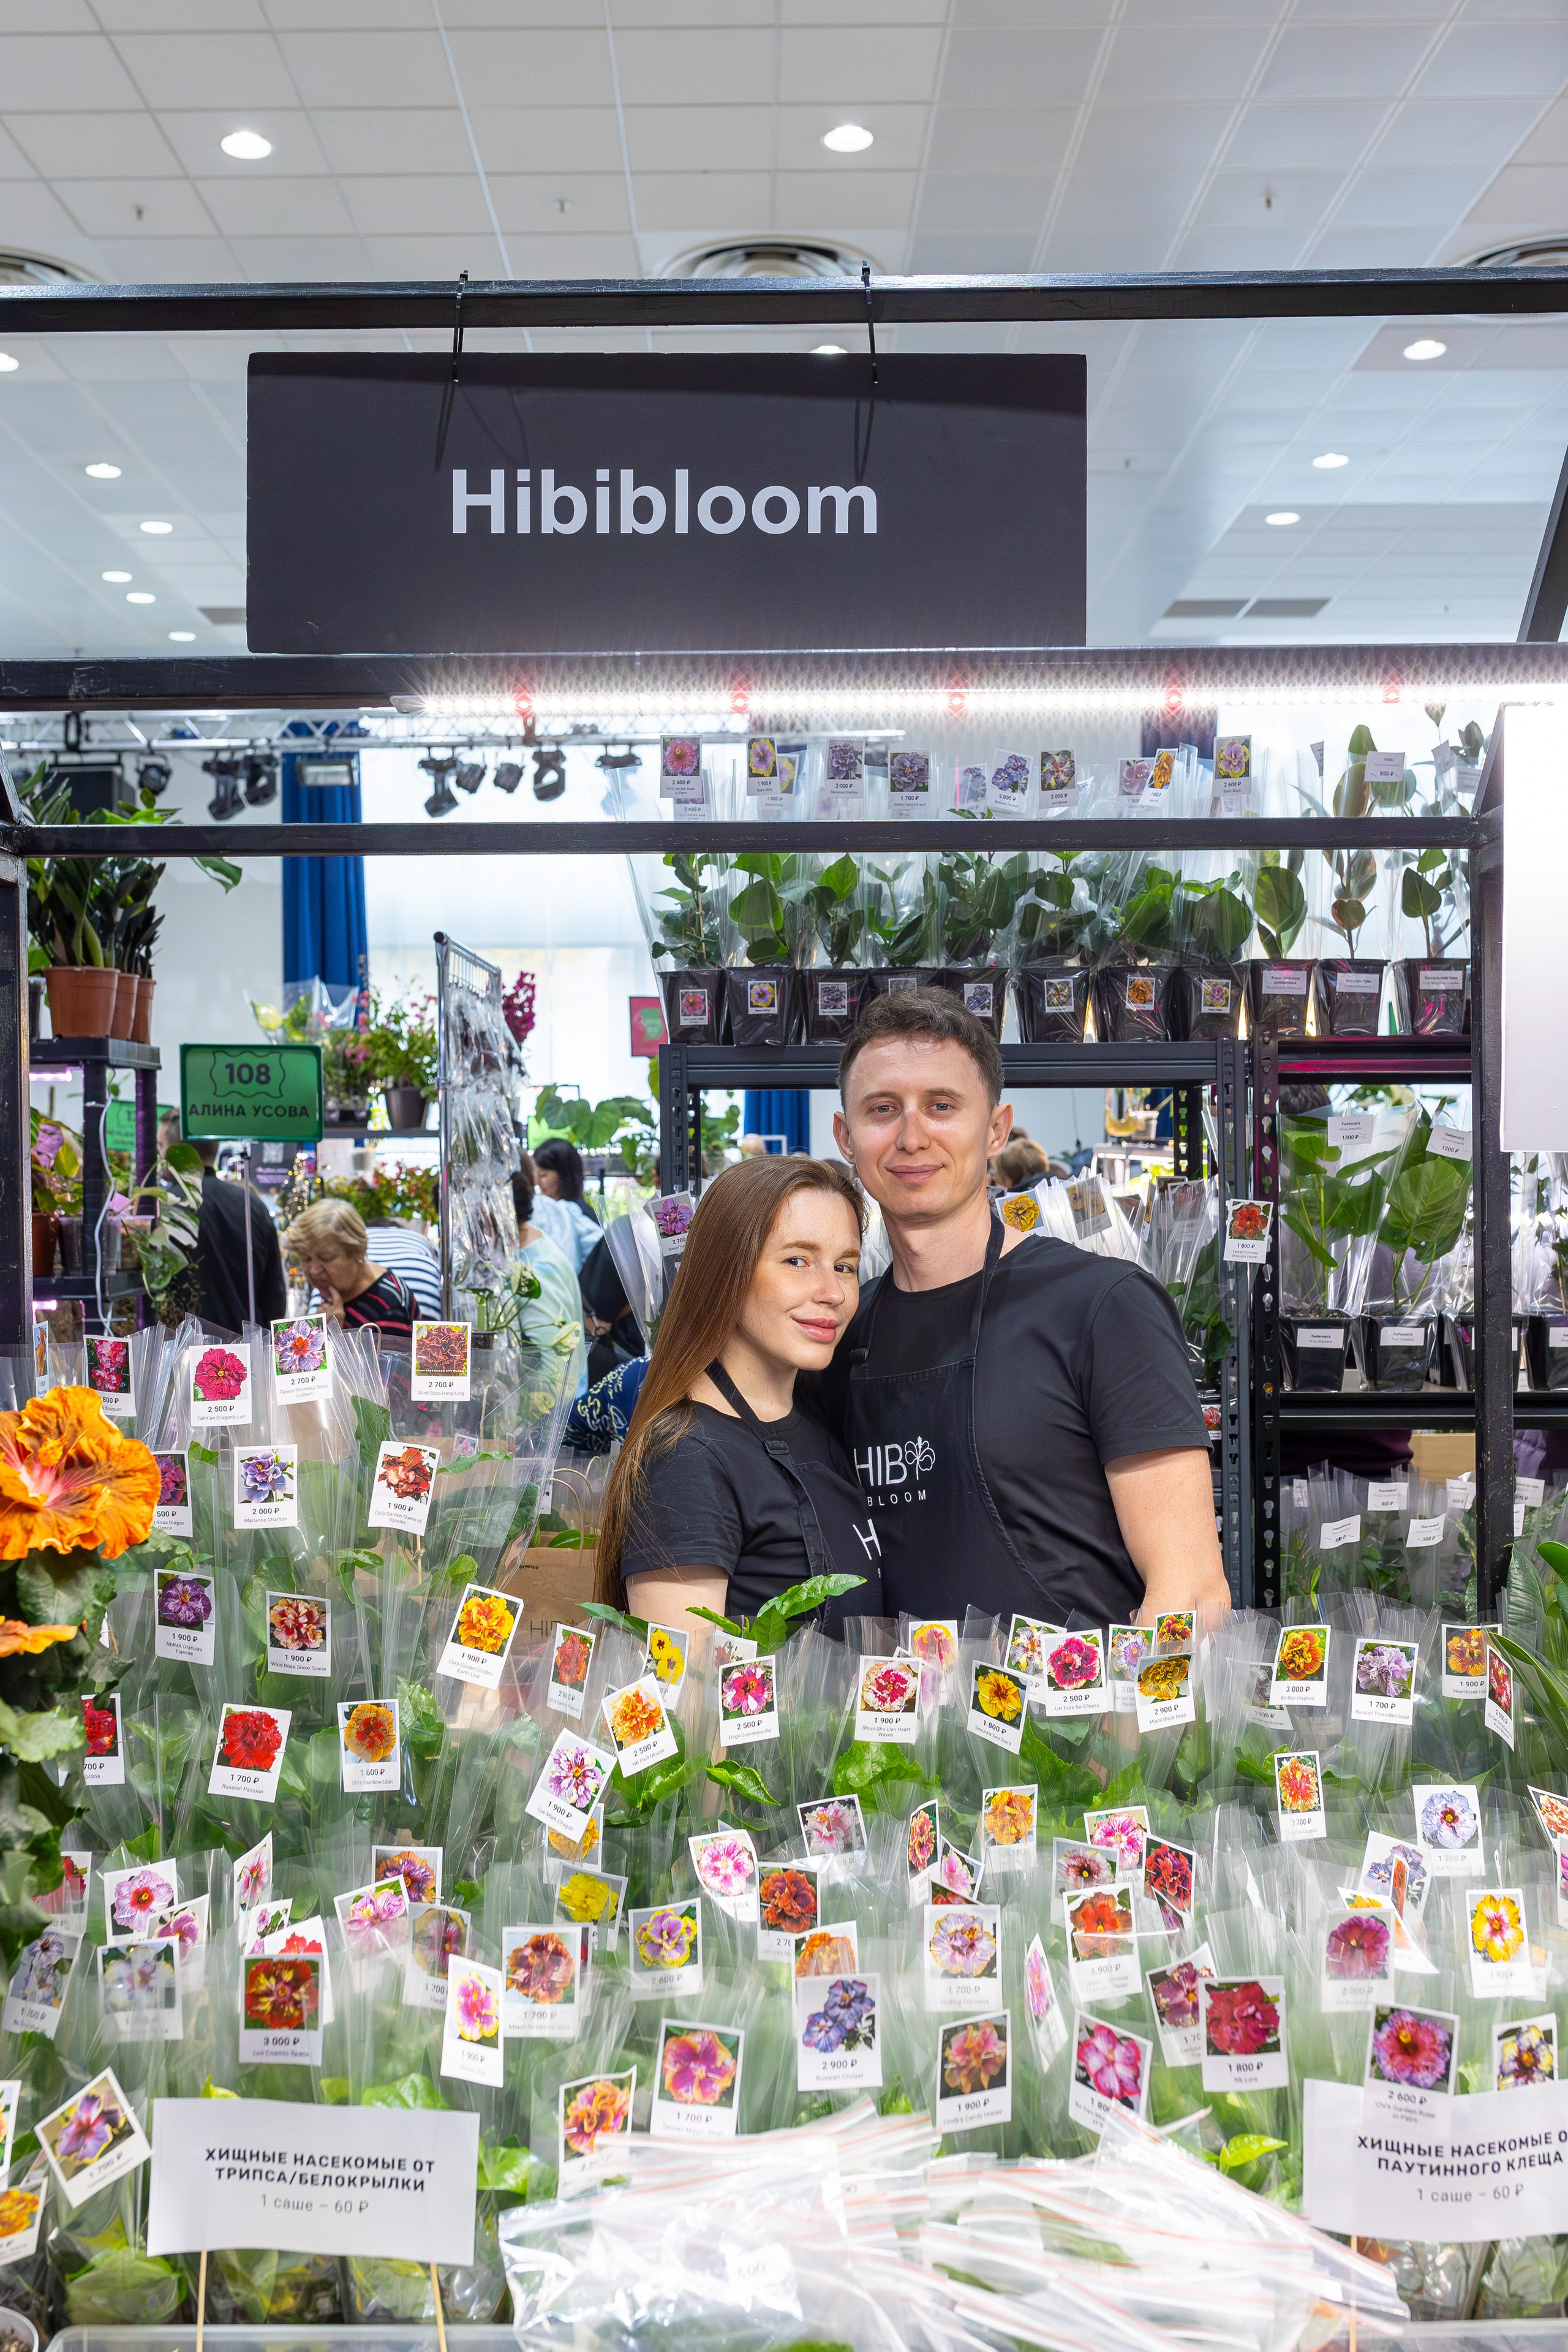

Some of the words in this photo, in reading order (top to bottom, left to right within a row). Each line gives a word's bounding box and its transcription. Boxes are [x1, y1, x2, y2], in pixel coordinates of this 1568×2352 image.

[452, 469, 877, 535] Hibibloom
[224, 1062, 271, 1085] 108
[189, 1103, 246, 1117] АЛИНА
[252, 1104, 311, 1119] УСОВА
[853, 1443, 908, 1487] HIB
[867, 1489, 927, 1507] BLOOM
[393, 1502, 407, 1511] 900
[389, 1517, 406, 1525] Spades
[402, 1513, 417, 1522] Queen
[178, 1633, 191, 1642] 900
[1159, 1705, 1172, 1714] 900
[742, 1721, 755, 1729] 500
[987, 1722, 1000, 1732] 800
[638, 1743, 652, 1754] 500
[236, 1774, 251, 1783] 700
[552, 1803, 566, 1815] 900
[263, 2037, 270, 2046] 3
[271, 2037, 290, 2046] 000
[822, 2061, 827, 2070] 2
[830, 2060, 848, 2068] 900
[1357, 2135, 1443, 2158] ХИЩНЫЕ
[1450, 2132, 1552, 2158] НАСЕКОМЫЕ
[1558, 2130, 1567, 2143] О
[205, 2148, 287, 2164] ХИЩНЫЕ
[293, 2152, 406, 2171] НАСЕКОМЫЕ
[413, 2160, 434, 2173] ОТ
[1378, 2157, 1501, 2176] ПАУТИННОГО
[1506, 2150, 1563, 2171] КЛЕЩА
[215, 2167, 424, 2192] ТРИПСА/БЕЛОКРЫЛКИ
[1416, 2187, 1423, 2201] 1
[1430, 2190, 1472, 2203] саше
[1492, 2185, 1510, 2200] 60
[261, 2194, 266, 2207] 1
[273, 2197, 313, 2212] саше
[334, 2199, 353, 2214] 60
